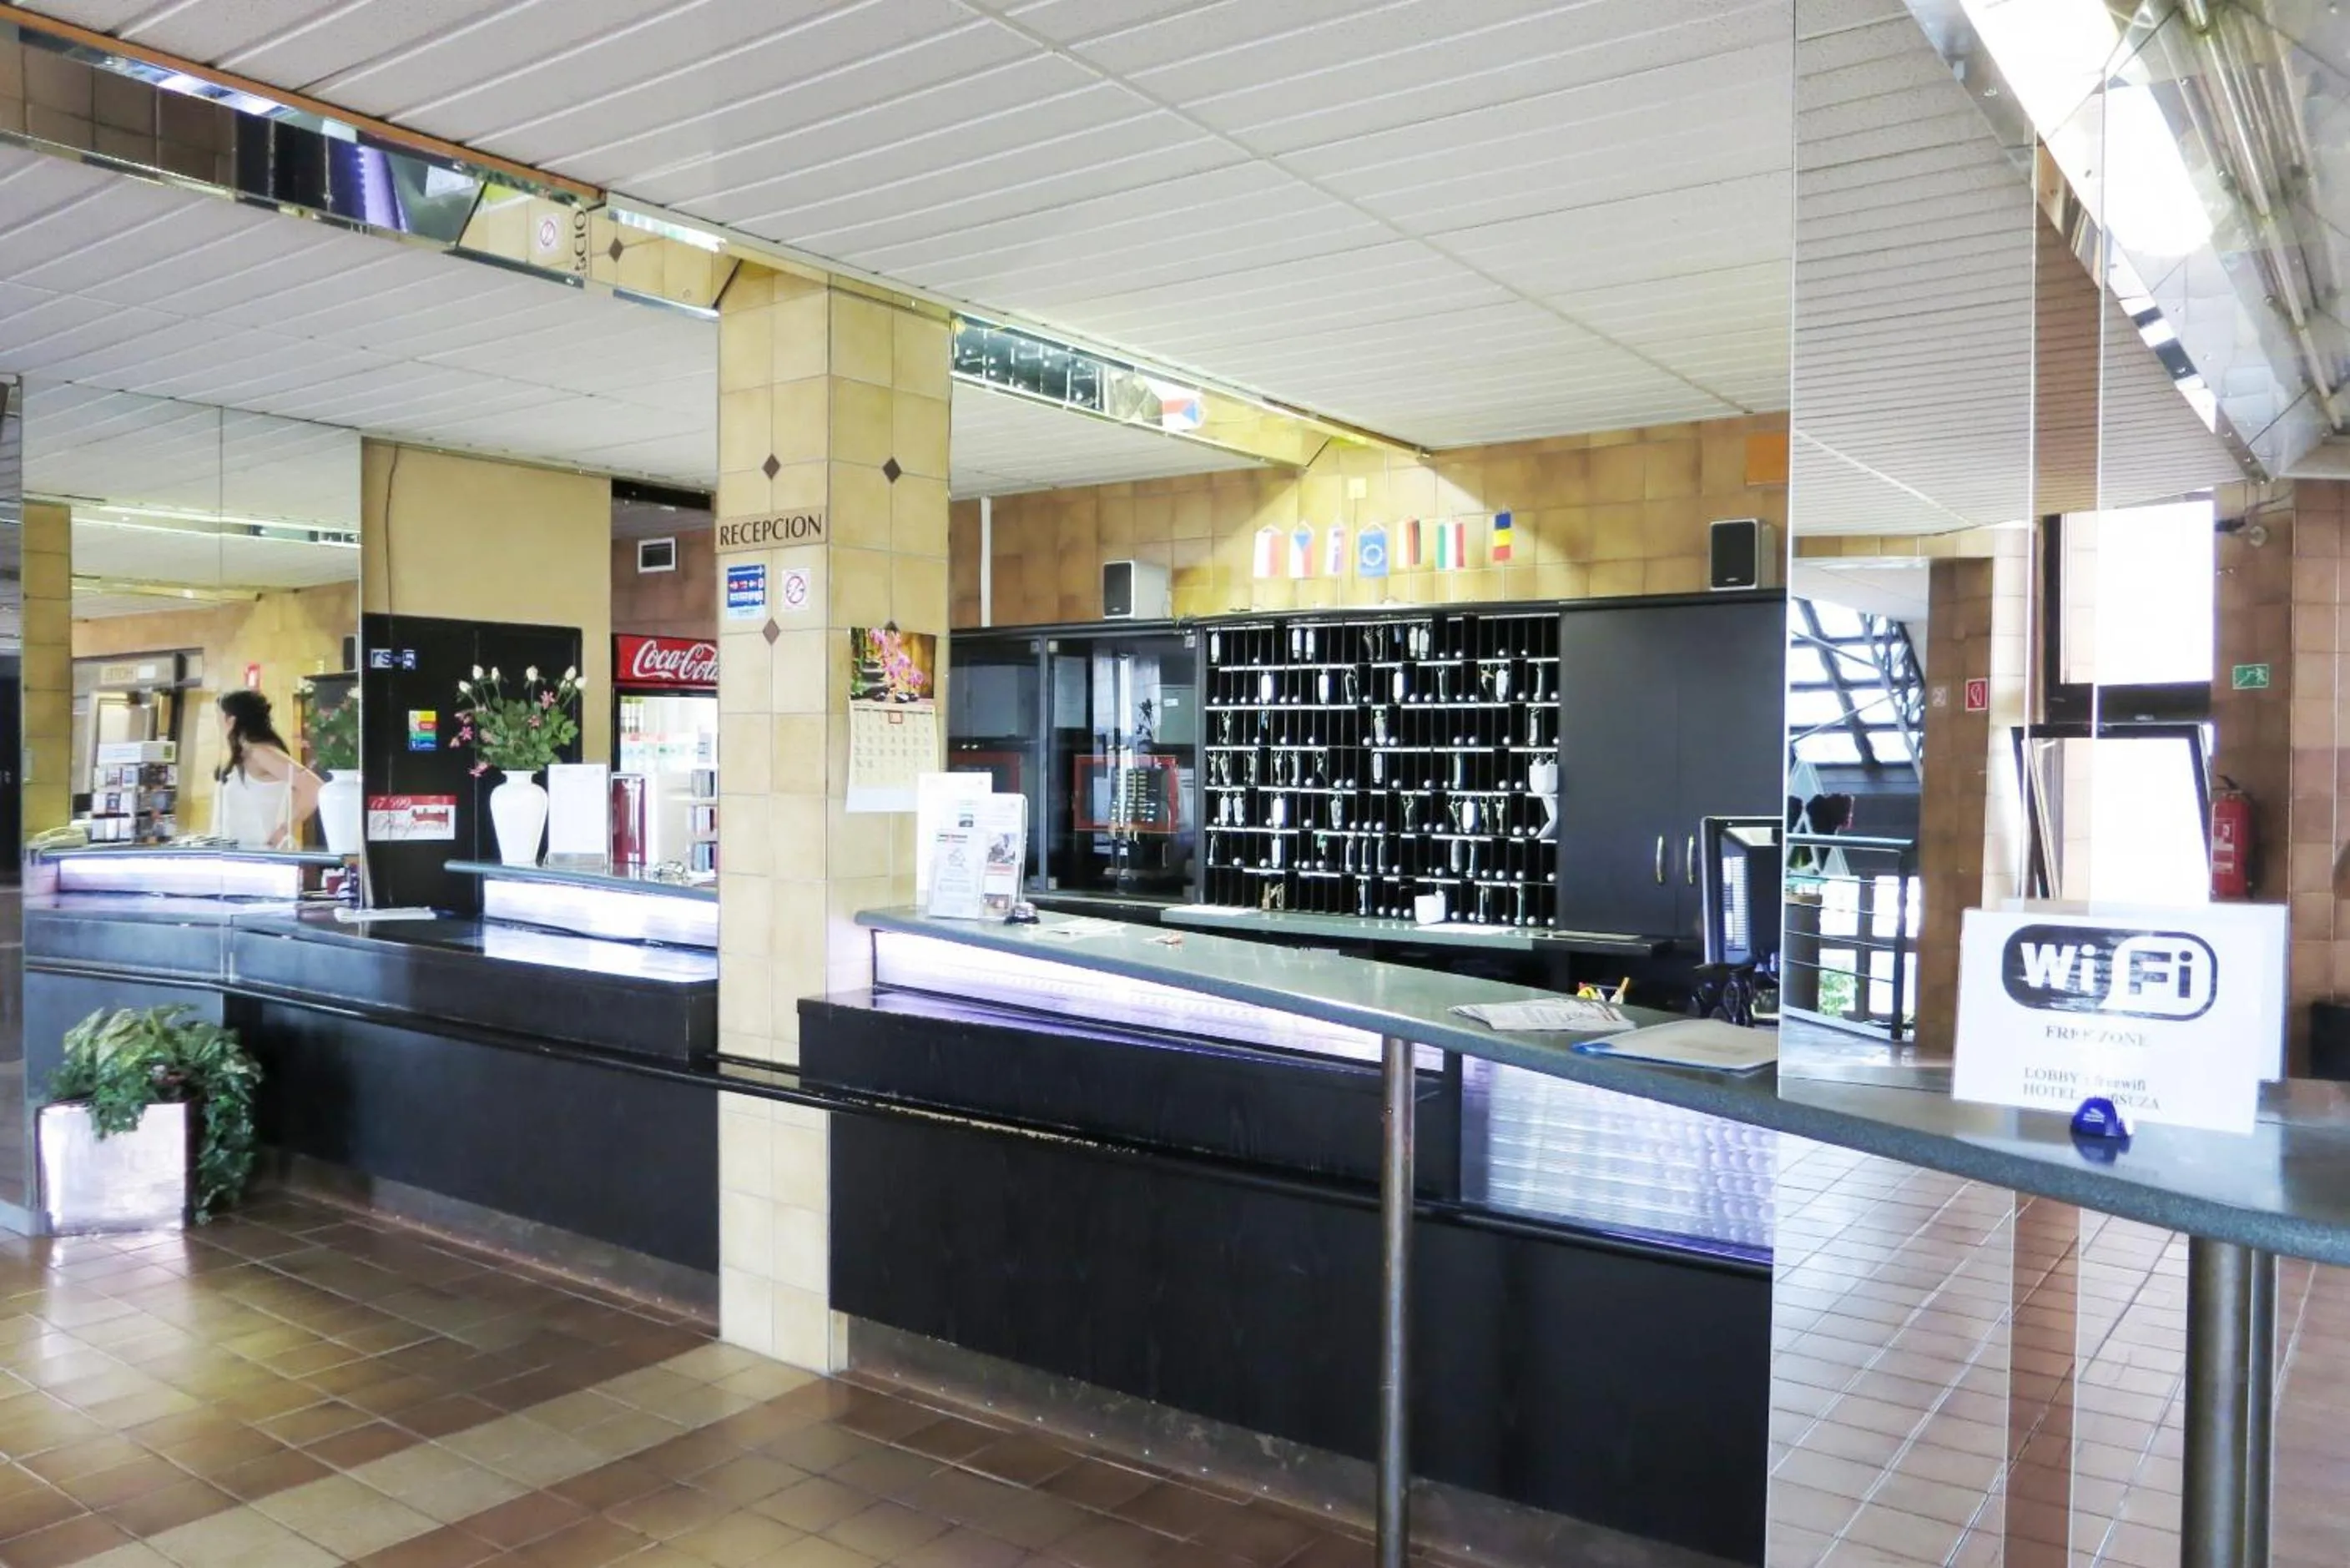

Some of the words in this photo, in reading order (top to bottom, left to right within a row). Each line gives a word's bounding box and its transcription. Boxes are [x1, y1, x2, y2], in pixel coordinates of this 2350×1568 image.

[719, 513, 822, 547] RECEPCION
[2020, 942, 2193, 999] WiFi
[2097, 1030, 2151, 1047] ZONE
[2025, 1066, 2080, 1084] LOBBY
[2023, 1082, 2079, 1101] HOTEL
